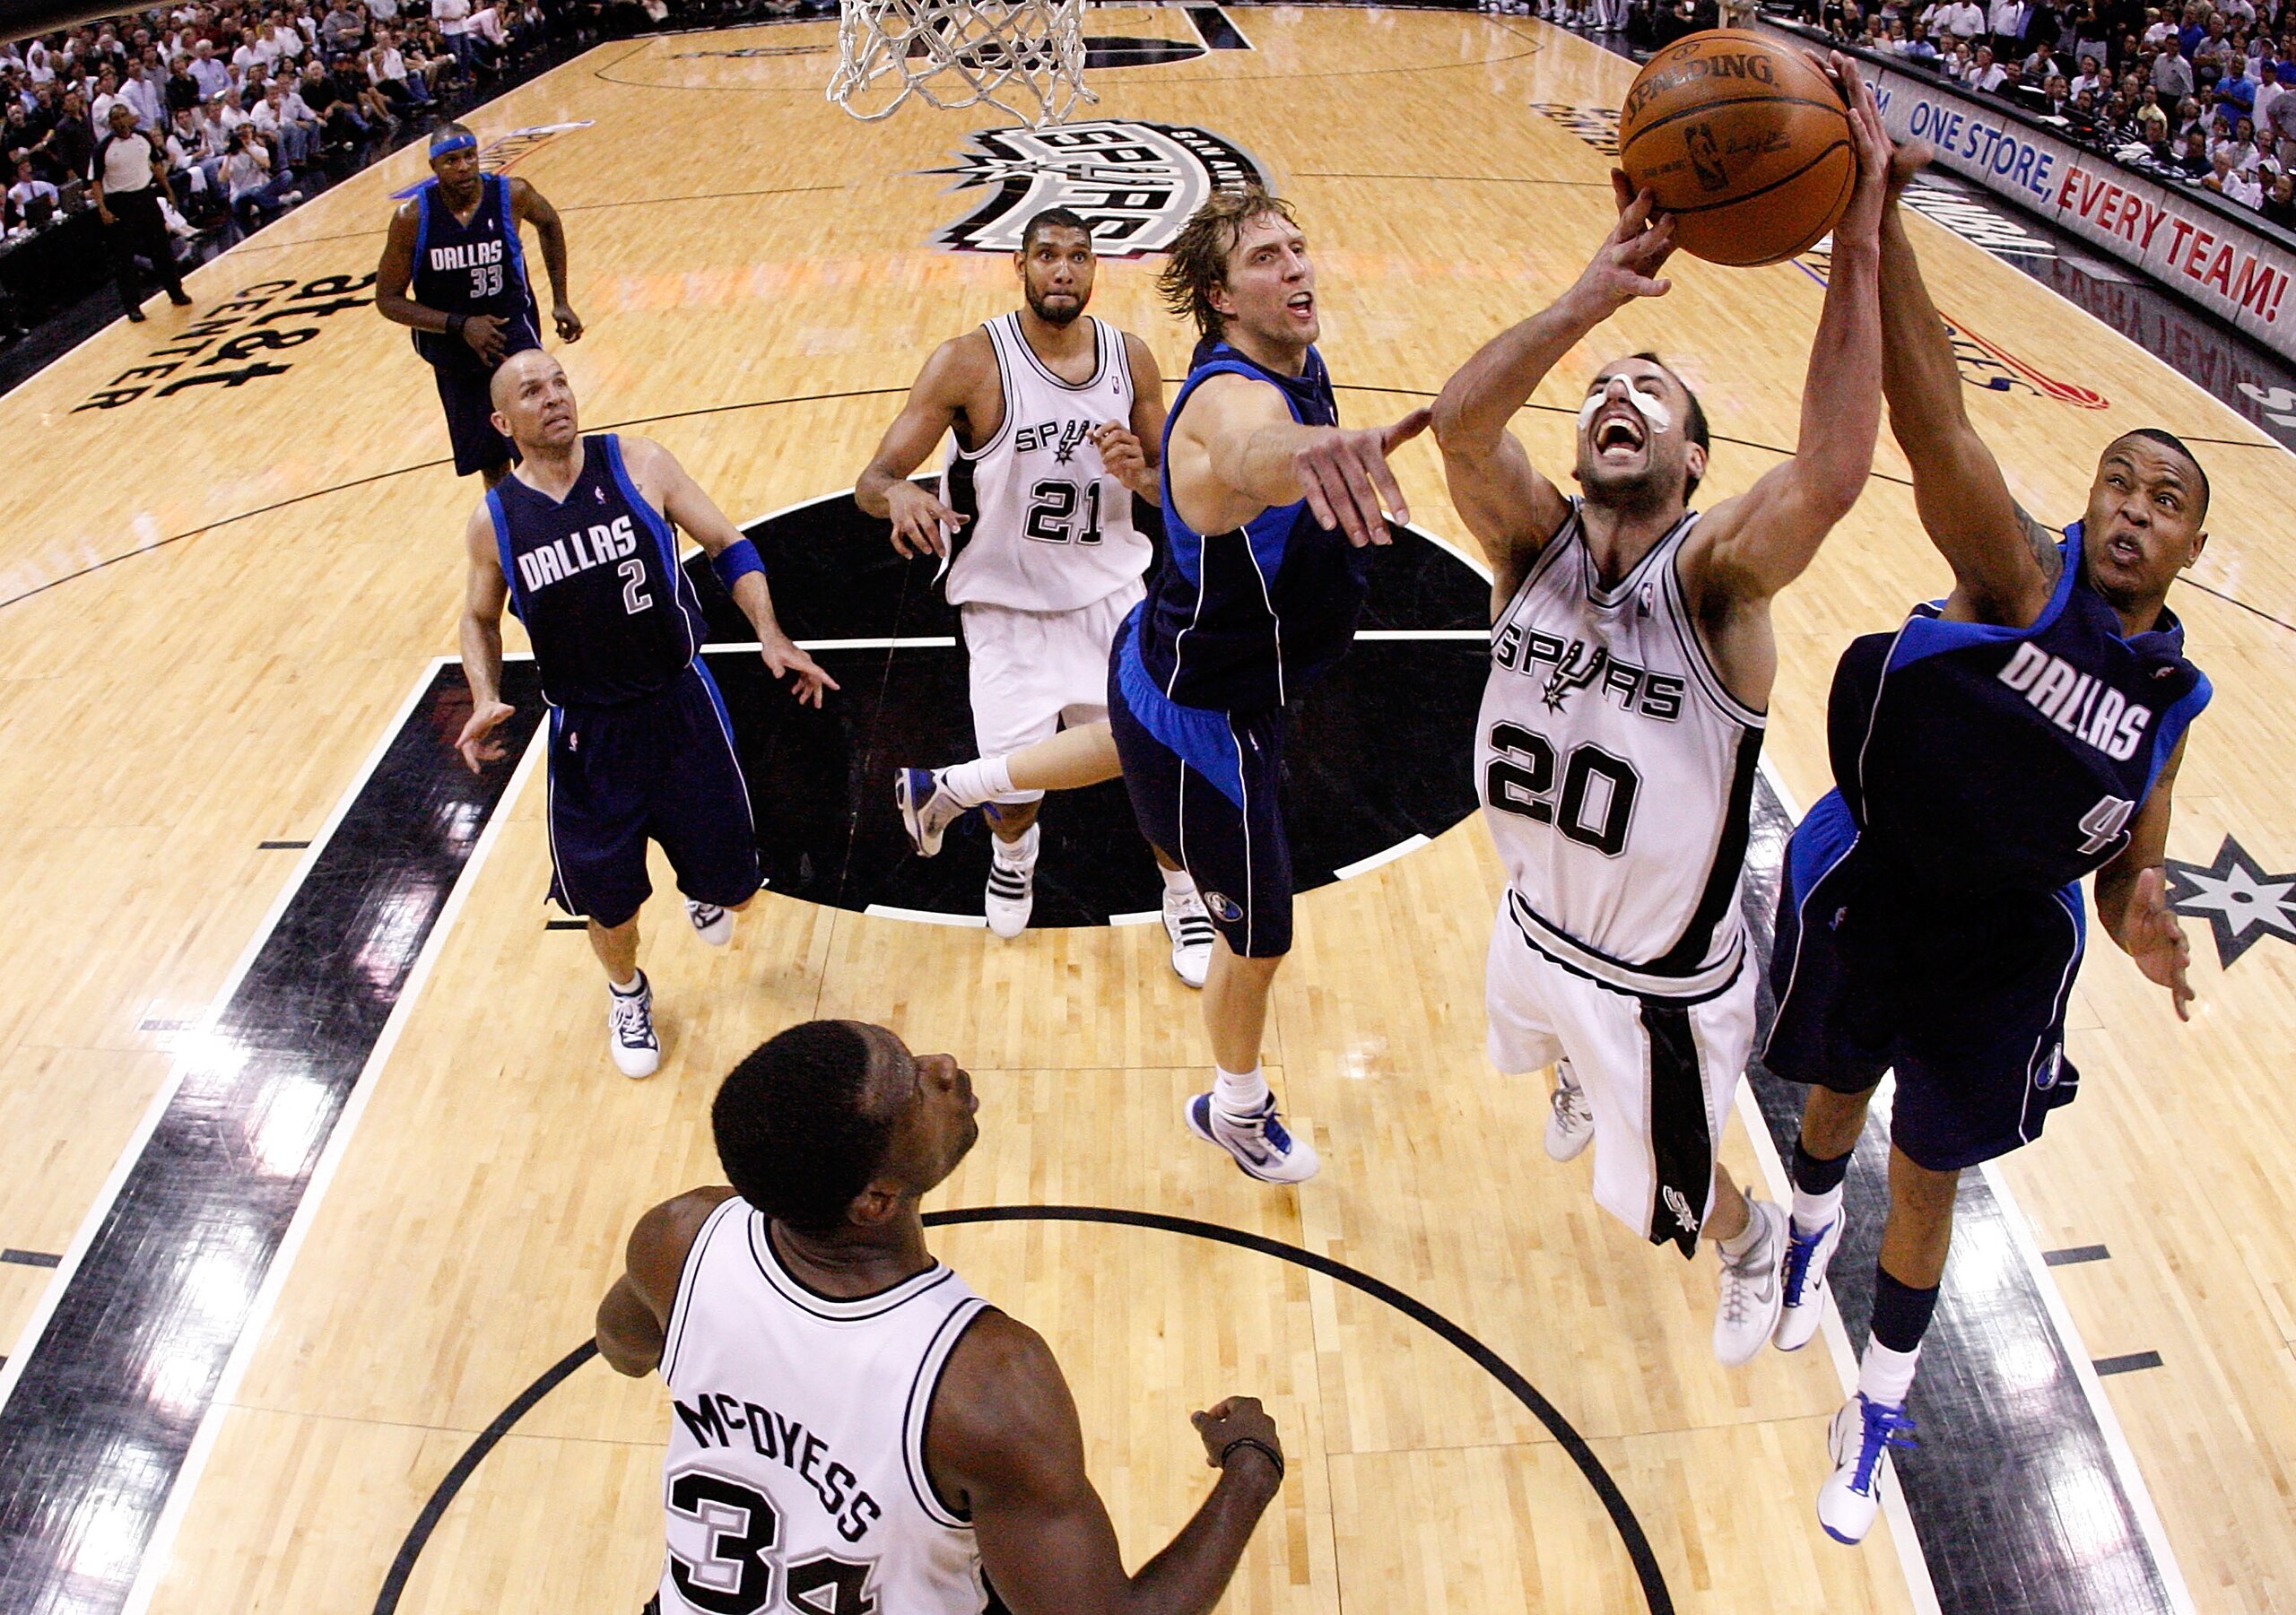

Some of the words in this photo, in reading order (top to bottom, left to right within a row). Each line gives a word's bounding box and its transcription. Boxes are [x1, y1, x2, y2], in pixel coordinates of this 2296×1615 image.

[1627, 53, 1775, 126] SPALDING
[1170, 131, 1226, 156] SAN
[1909, 101, 1964, 152] ONE
[1961, 123, 2054, 203] STORE,
[2057, 166, 2166, 249] EVERY
[2166, 218, 2290, 323] TEAM!
[430, 239, 502, 271] DALLAS
[470, 265, 503, 298] 33
[69, 279, 298, 413] CENTER
[1022, 478, 1103, 546] 21
[517, 514, 638, 593] DALLAS
[617, 558, 654, 615] 2
[1494, 621, 1687, 724] SPURS
[1996, 640, 2152, 761] DALLAS
[1484, 718, 1644, 860] 20
[2076, 794, 2136, 855] 4
